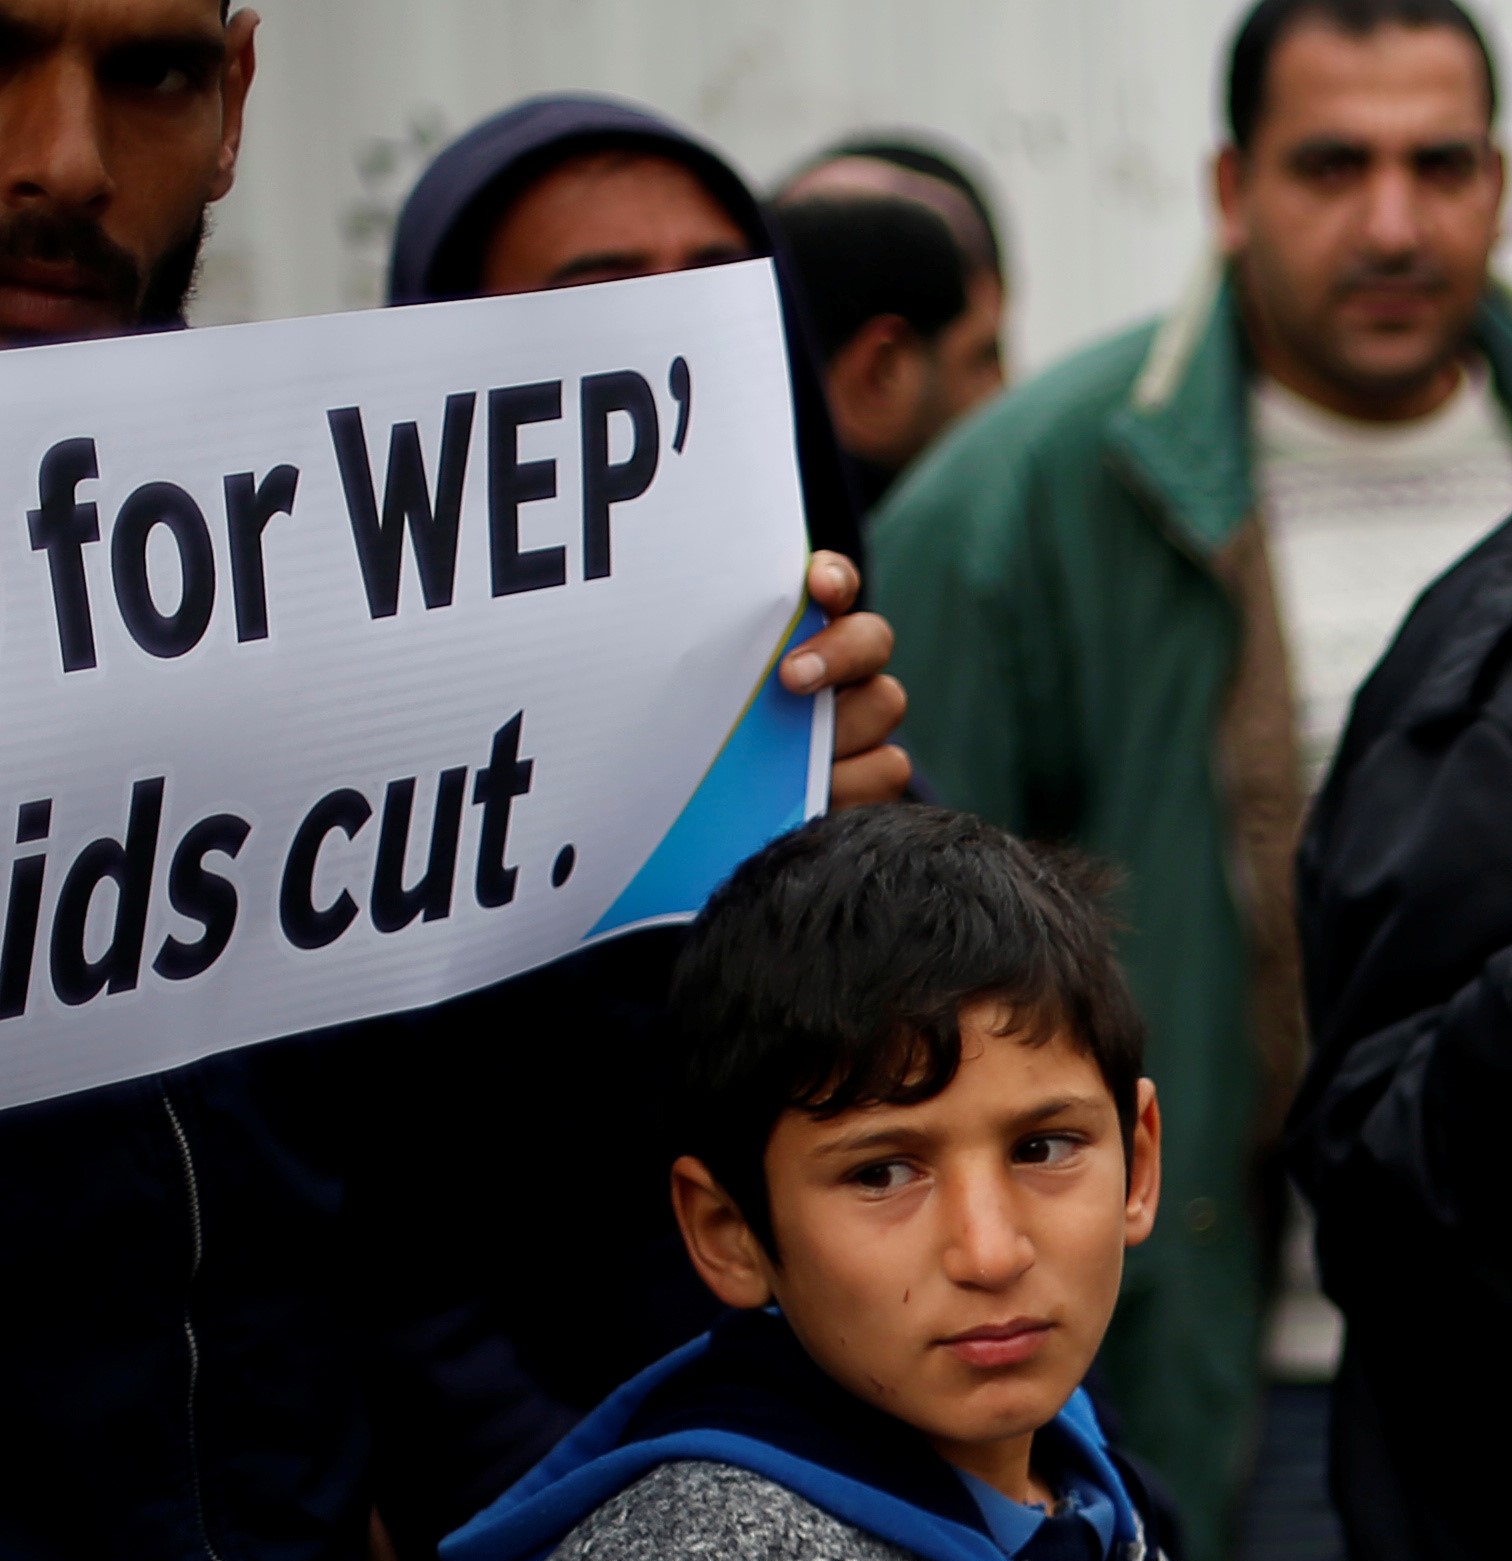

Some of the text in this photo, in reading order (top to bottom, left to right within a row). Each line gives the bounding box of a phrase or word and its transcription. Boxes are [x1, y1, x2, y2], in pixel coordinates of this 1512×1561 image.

[27, 355, 692, 674] for WEP'
[0, 776, 253, 1022] ids
